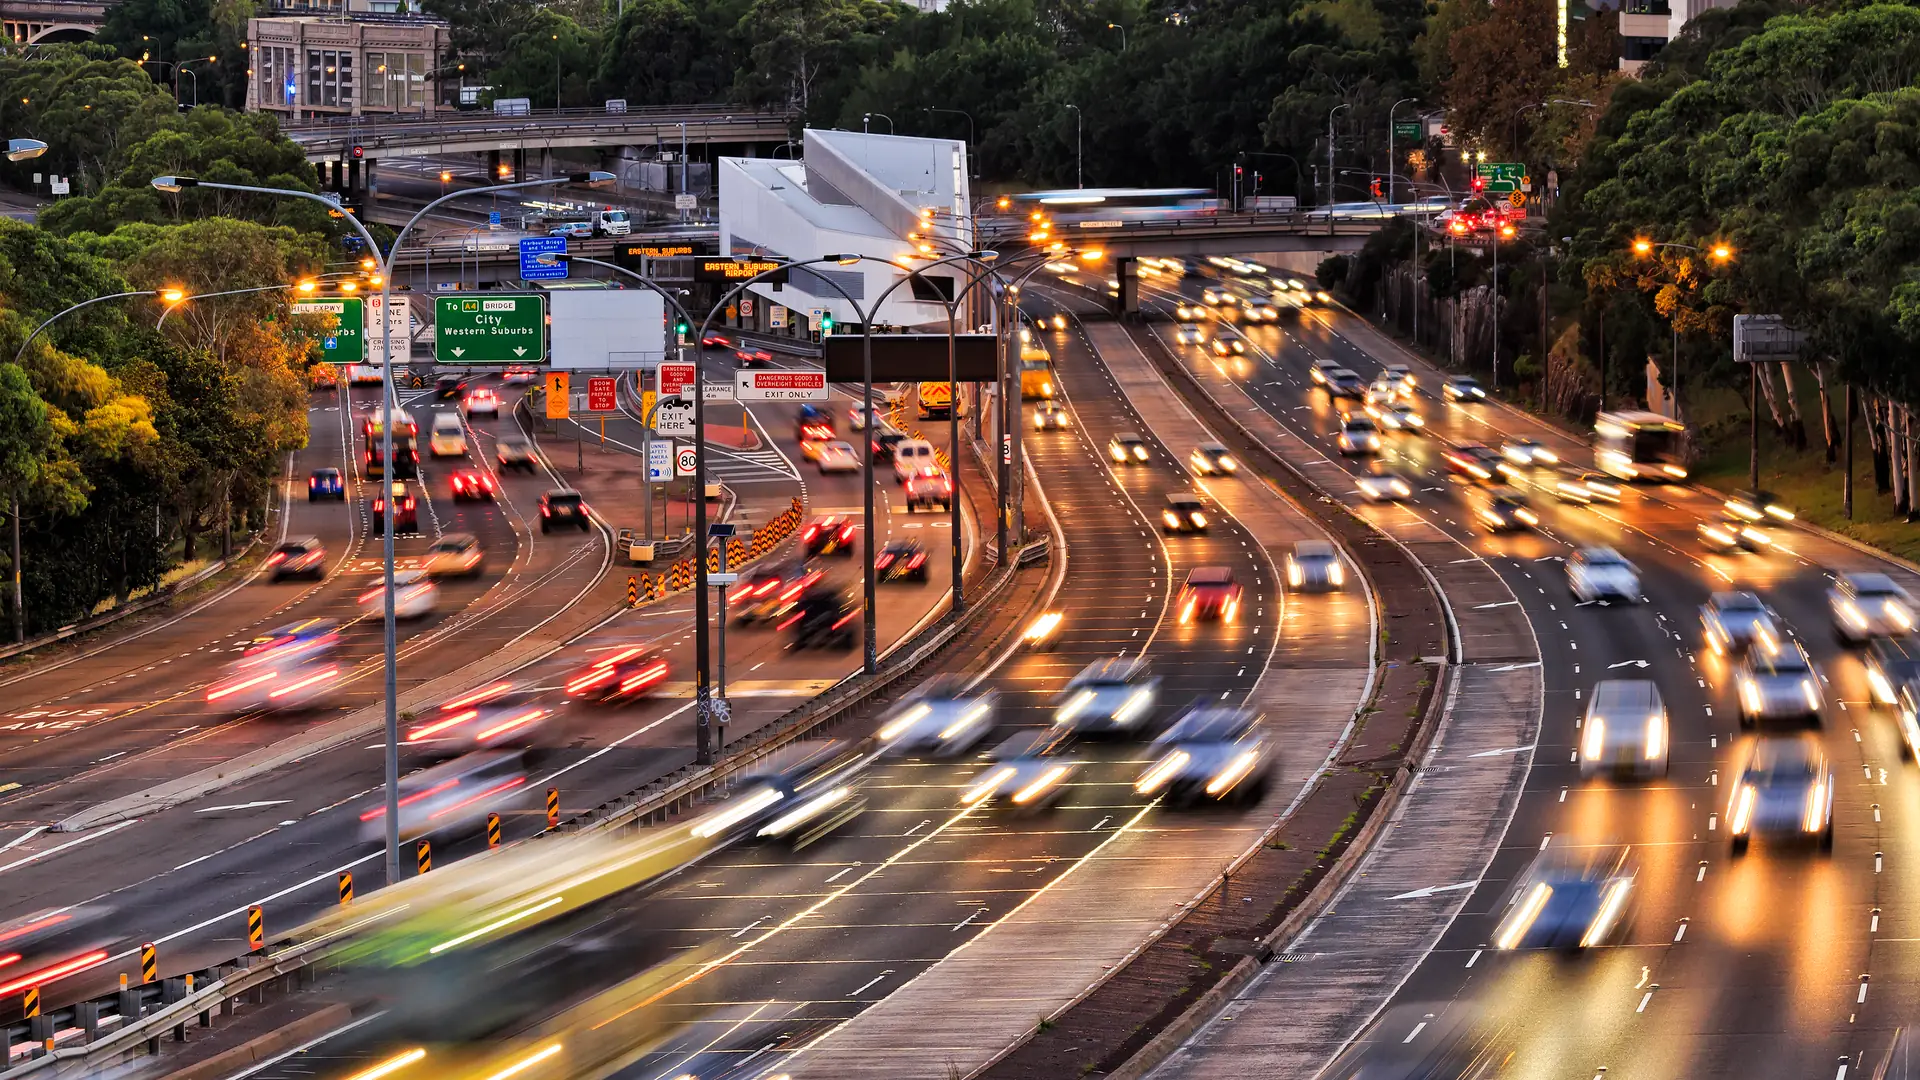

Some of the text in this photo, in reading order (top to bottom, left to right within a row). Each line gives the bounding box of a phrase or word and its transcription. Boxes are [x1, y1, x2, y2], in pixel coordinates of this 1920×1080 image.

[705, 263, 779, 271] EASTERN SUBURBS
[446, 302, 458, 310] To
[475, 314, 502, 325] City
[444, 327, 486, 335] Western
[660, 422, 685, 430] HERE
[681, 455, 696, 467] 80
[14, 709, 109, 718] BUS
[0, 720, 87, 730] ANE
